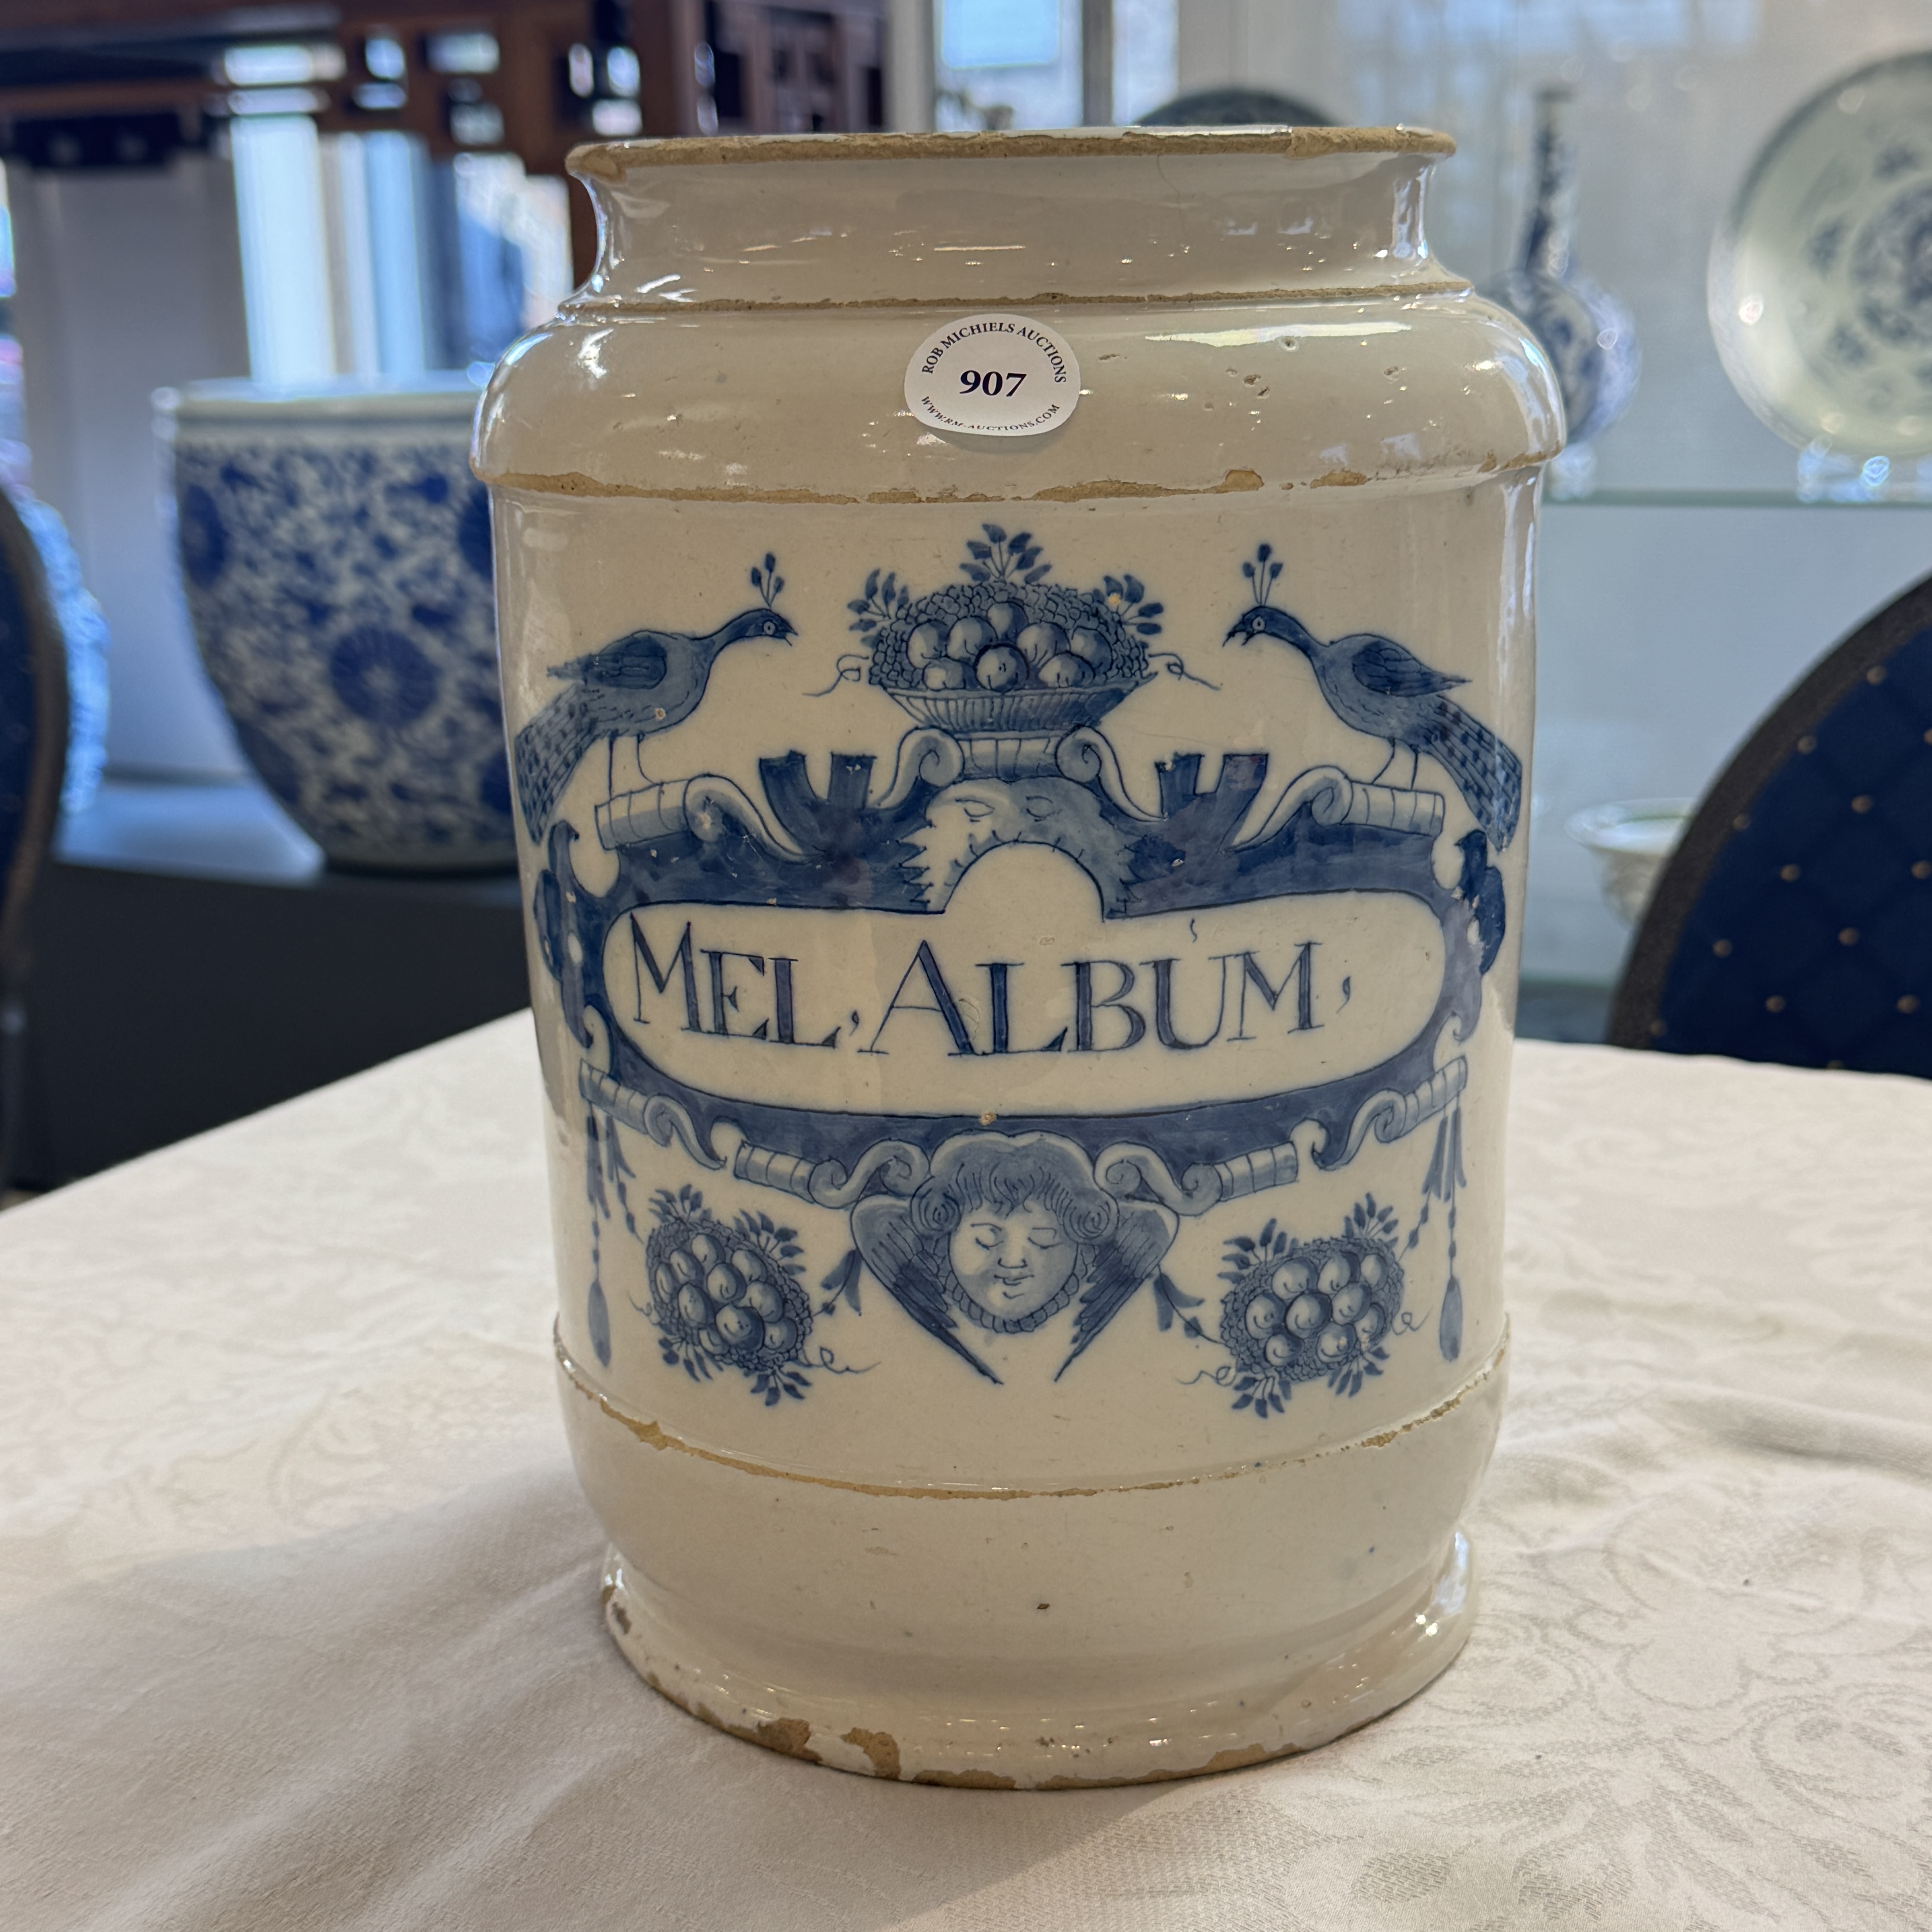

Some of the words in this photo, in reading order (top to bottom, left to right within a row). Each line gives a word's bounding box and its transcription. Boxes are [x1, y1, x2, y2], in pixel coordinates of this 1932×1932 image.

[922, 347, 943, 374] ROB
[940, 322, 1016, 349] MICHIELS
[1017, 327, 1066, 383] AUCTIONS
[959, 370, 1027, 397] 907
[921, 396, 1060, 431] WWW.RM-AUCTIONS.COM
